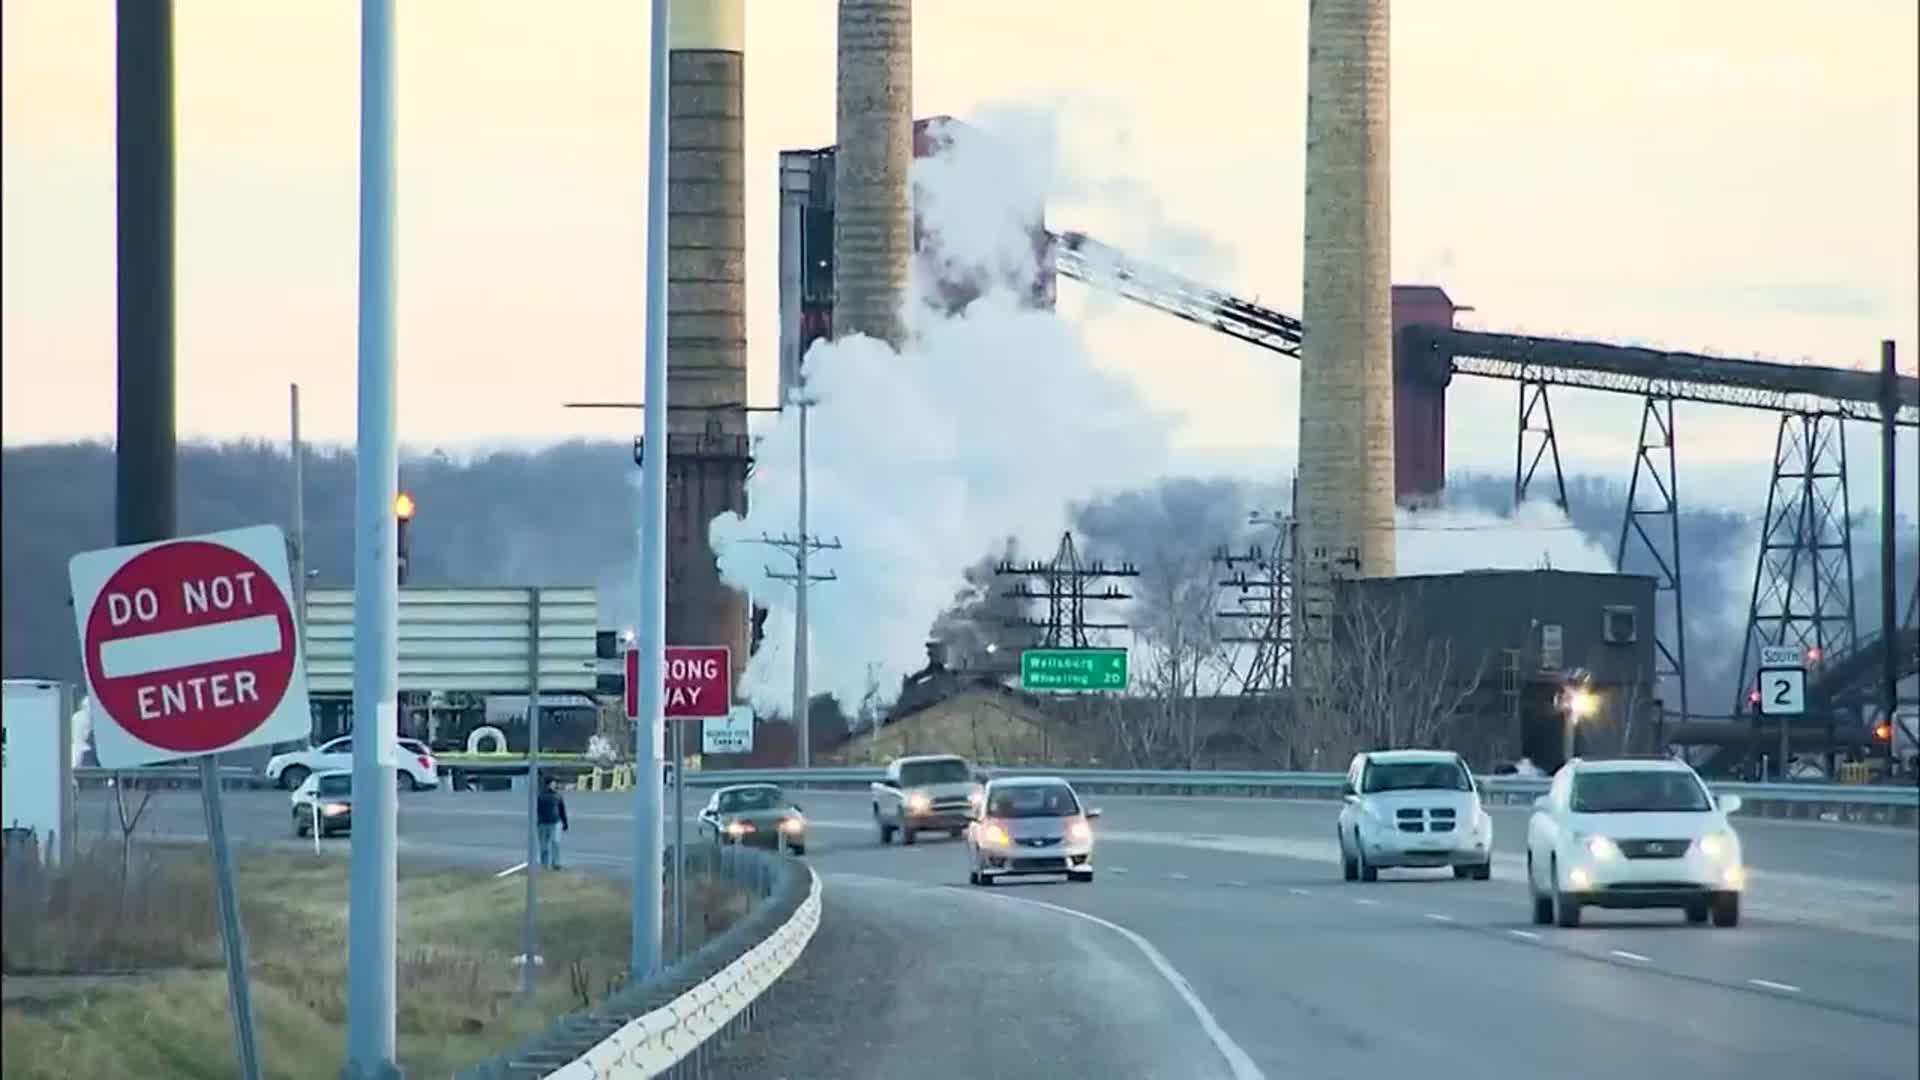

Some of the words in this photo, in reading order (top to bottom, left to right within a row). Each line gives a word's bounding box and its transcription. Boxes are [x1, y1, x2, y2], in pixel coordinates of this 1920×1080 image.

[109, 588, 158, 626] DO
[183, 572, 255, 614] NOT
[665, 659, 718, 679] ONG
[1112, 657, 1120, 668] 4
[1030, 672, 1089, 685] Wheeling
[1104, 672, 1121, 683] 20
[137, 671, 260, 721] ENTER
[665, 687, 701, 705] AY
[1774, 680, 1791, 704] 2
